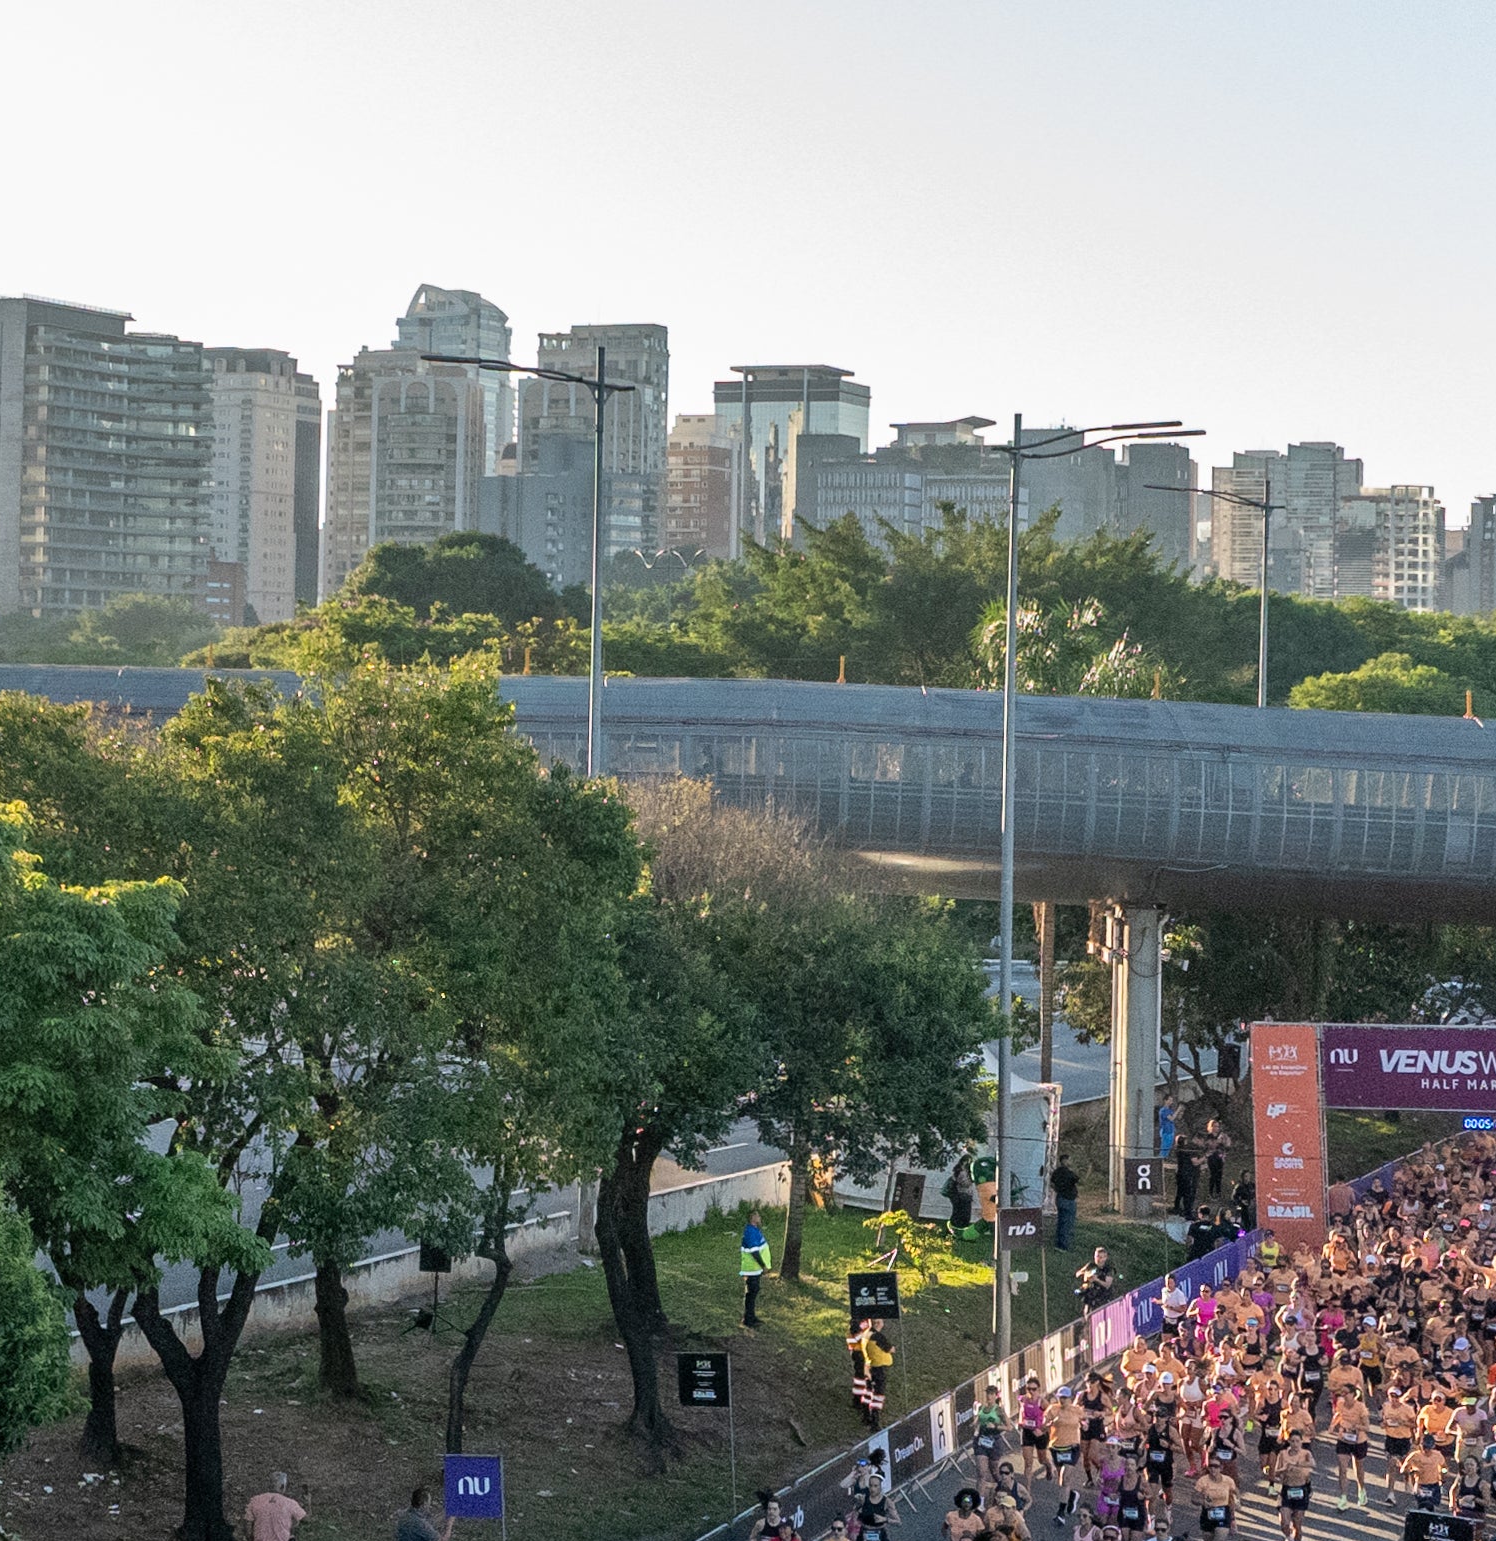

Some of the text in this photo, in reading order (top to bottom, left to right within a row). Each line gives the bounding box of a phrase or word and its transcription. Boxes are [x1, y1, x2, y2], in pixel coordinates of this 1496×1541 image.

[1330, 1048, 1358, 1064] nu
[1379, 1049, 1478, 1075] VENUS
[1421, 1078, 1459, 1090] HALF
[1267, 1205, 1314, 1218] BRASIL
[1008, 1221, 1036, 1236] rvb
[458, 1475, 491, 1496] nu
